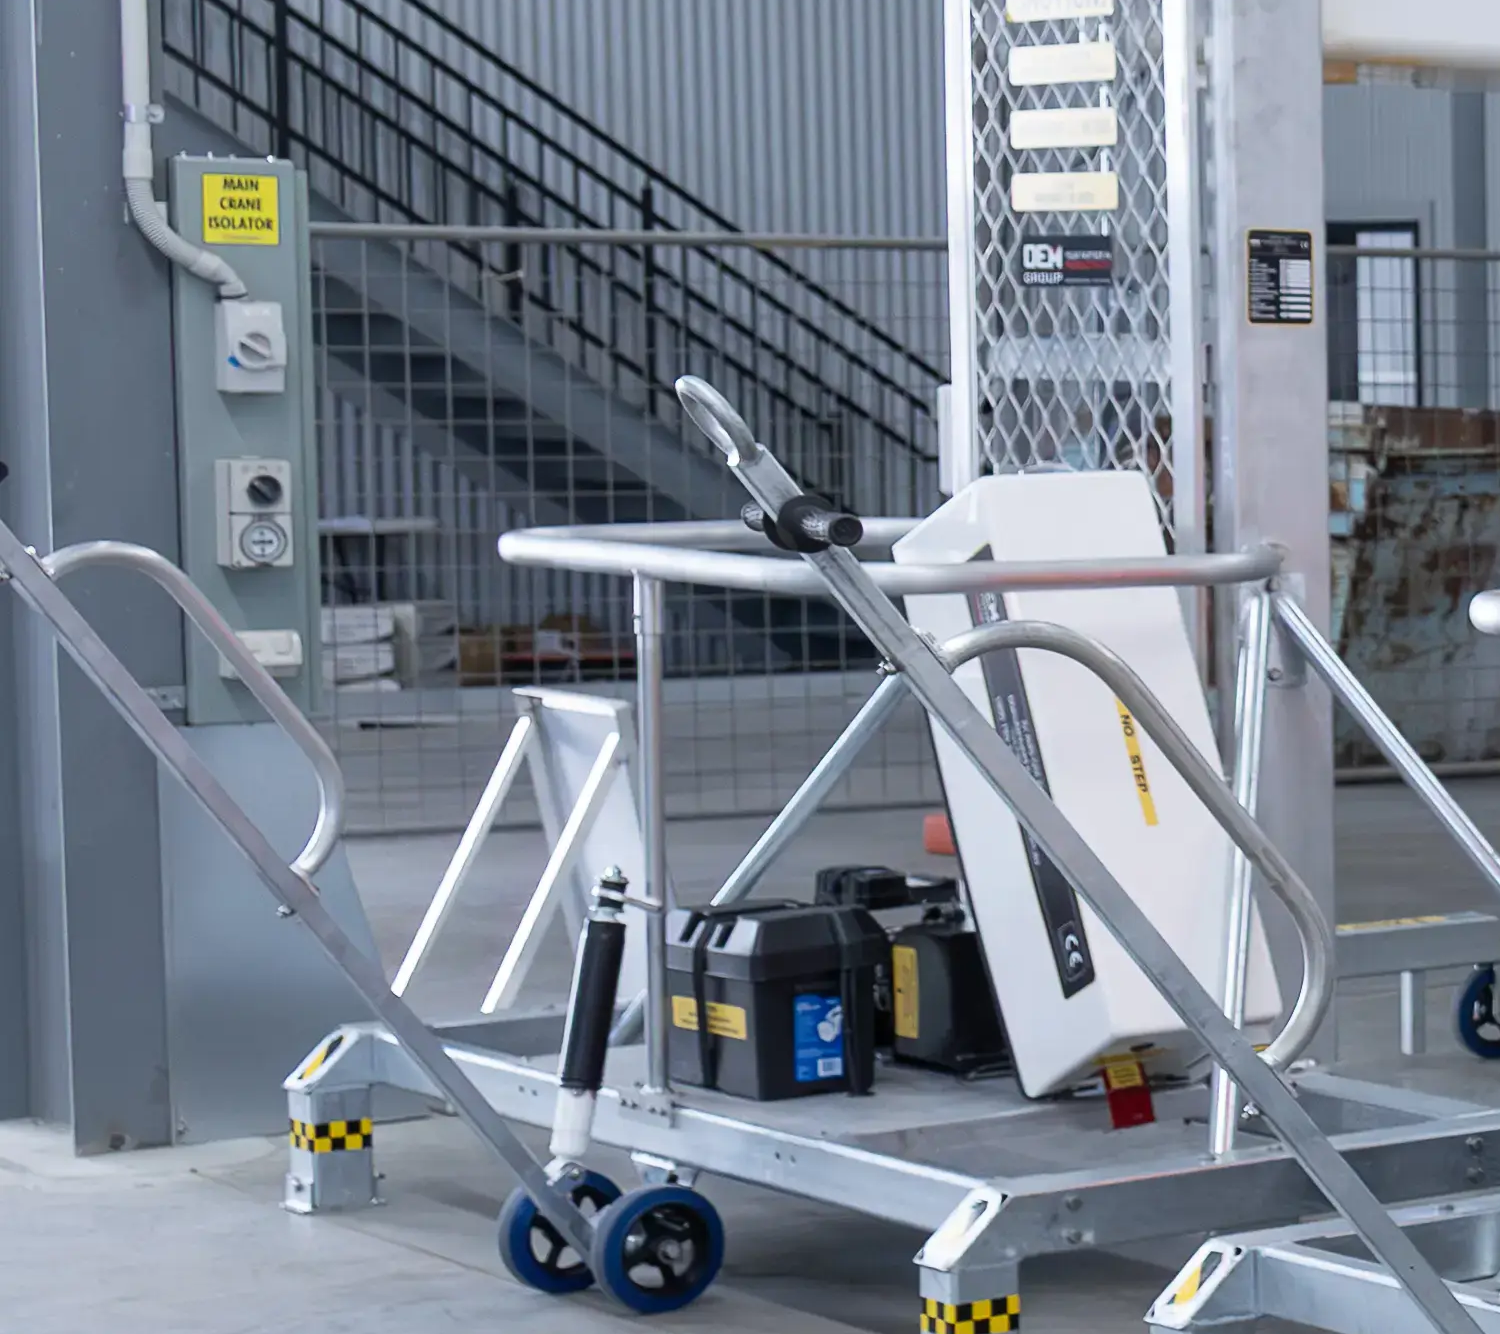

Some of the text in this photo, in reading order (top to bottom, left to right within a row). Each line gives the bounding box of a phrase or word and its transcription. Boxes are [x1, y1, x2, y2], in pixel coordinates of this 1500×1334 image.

[223, 178, 259, 191] MAIN
[208, 216, 273, 231] ISOLATOR
[1023, 243, 1063, 269] OEM
